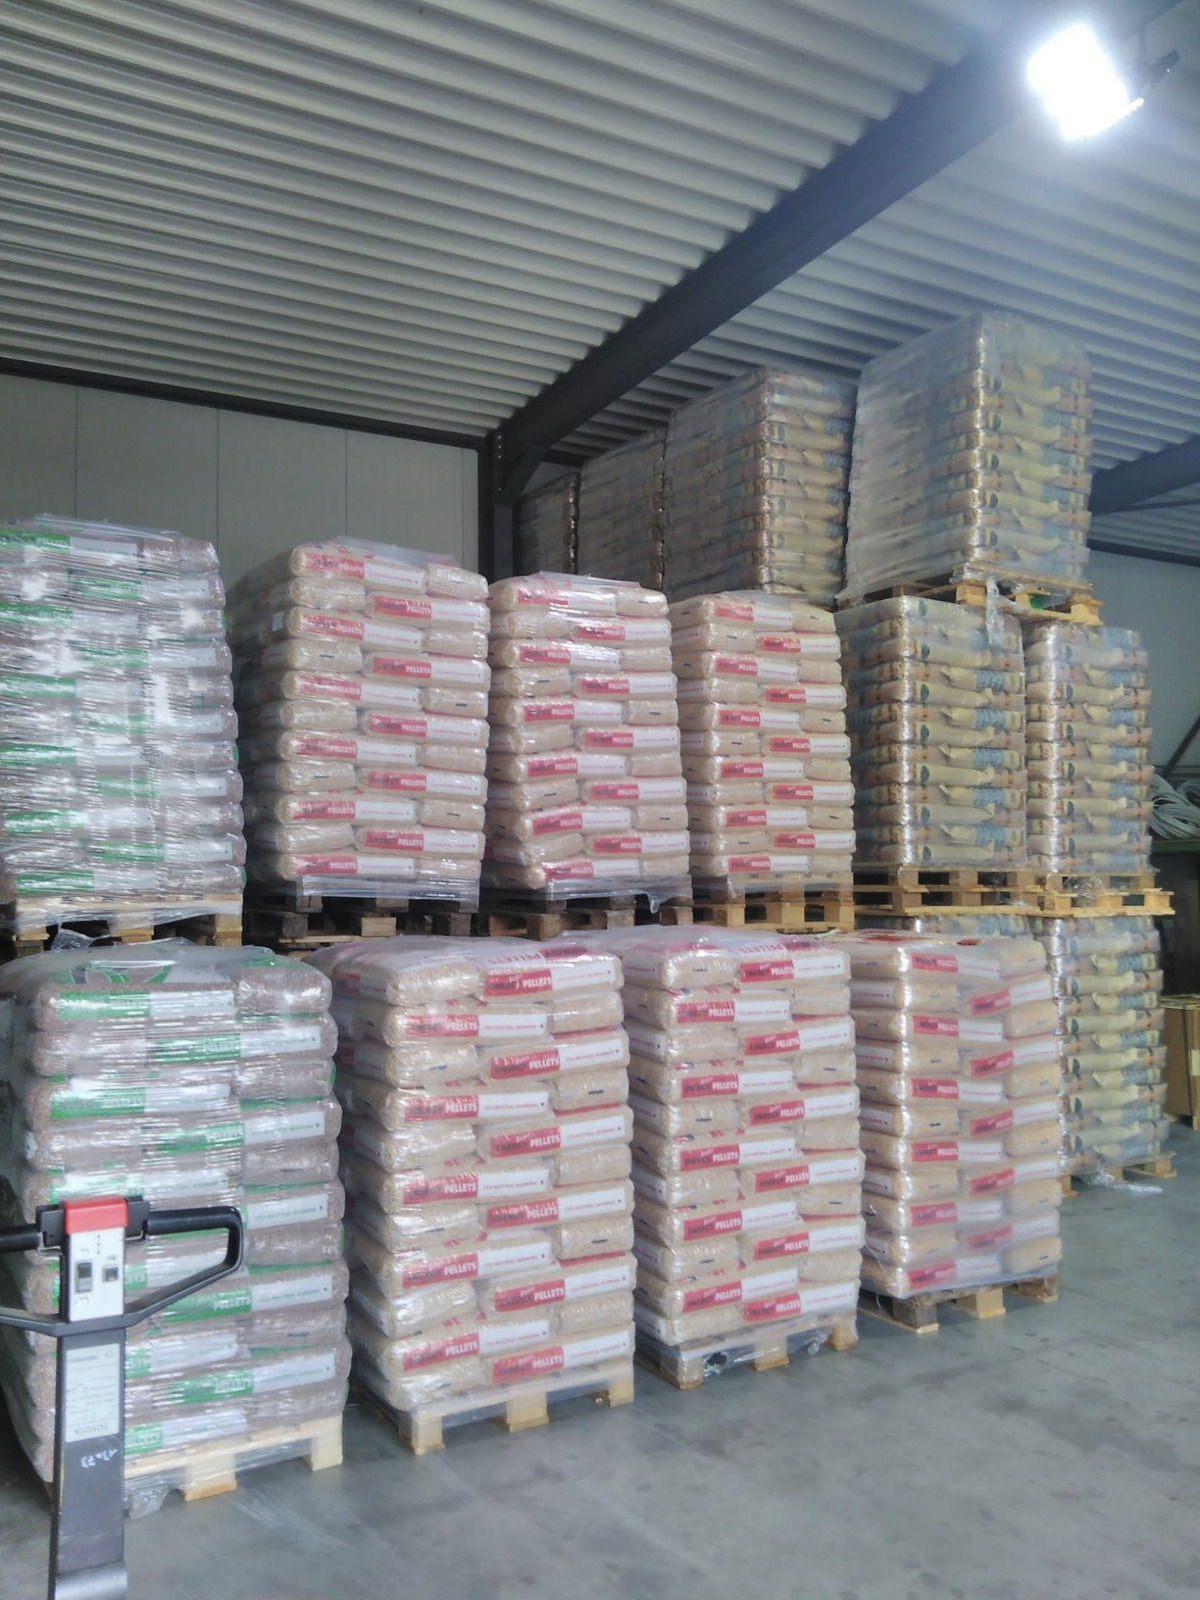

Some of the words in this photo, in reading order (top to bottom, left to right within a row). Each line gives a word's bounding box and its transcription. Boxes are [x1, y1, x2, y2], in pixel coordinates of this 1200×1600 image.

[770, 967, 794, 976] PELLETS
[522, 978, 552, 989] PELLETS
[710, 1008, 734, 1017] PELLETS
[447, 1023, 478, 1032] PELLETS
[776, 1039, 800, 1049] PELLETS
[529, 1058, 559, 1071] PELLETS
[714, 1082, 738, 1092] PELLETS
[446, 1104, 477, 1114] PELLETS
[781, 1108, 804, 1118] PELLETS
[530, 1136, 560, 1148] PELLETS
[714, 1152, 739, 1163] PELLETS
[785, 1172, 809, 1183] PELLETS
[445, 1183, 477, 1195] PELLETS
[527, 1207, 557, 1220] PELLETS
[716, 1218, 741, 1231] PELLETS
[785, 1241, 808, 1252] PELLETS
[445, 1262, 477, 1276] PELLETS
[534, 1288, 564, 1301] PELLETS
[716, 1288, 741, 1301] PELLETS
[775, 1301, 800, 1312] PELLETS
[446, 1341, 478, 1357] PELLETS
[533, 1355, 562, 1370] PELLETS
